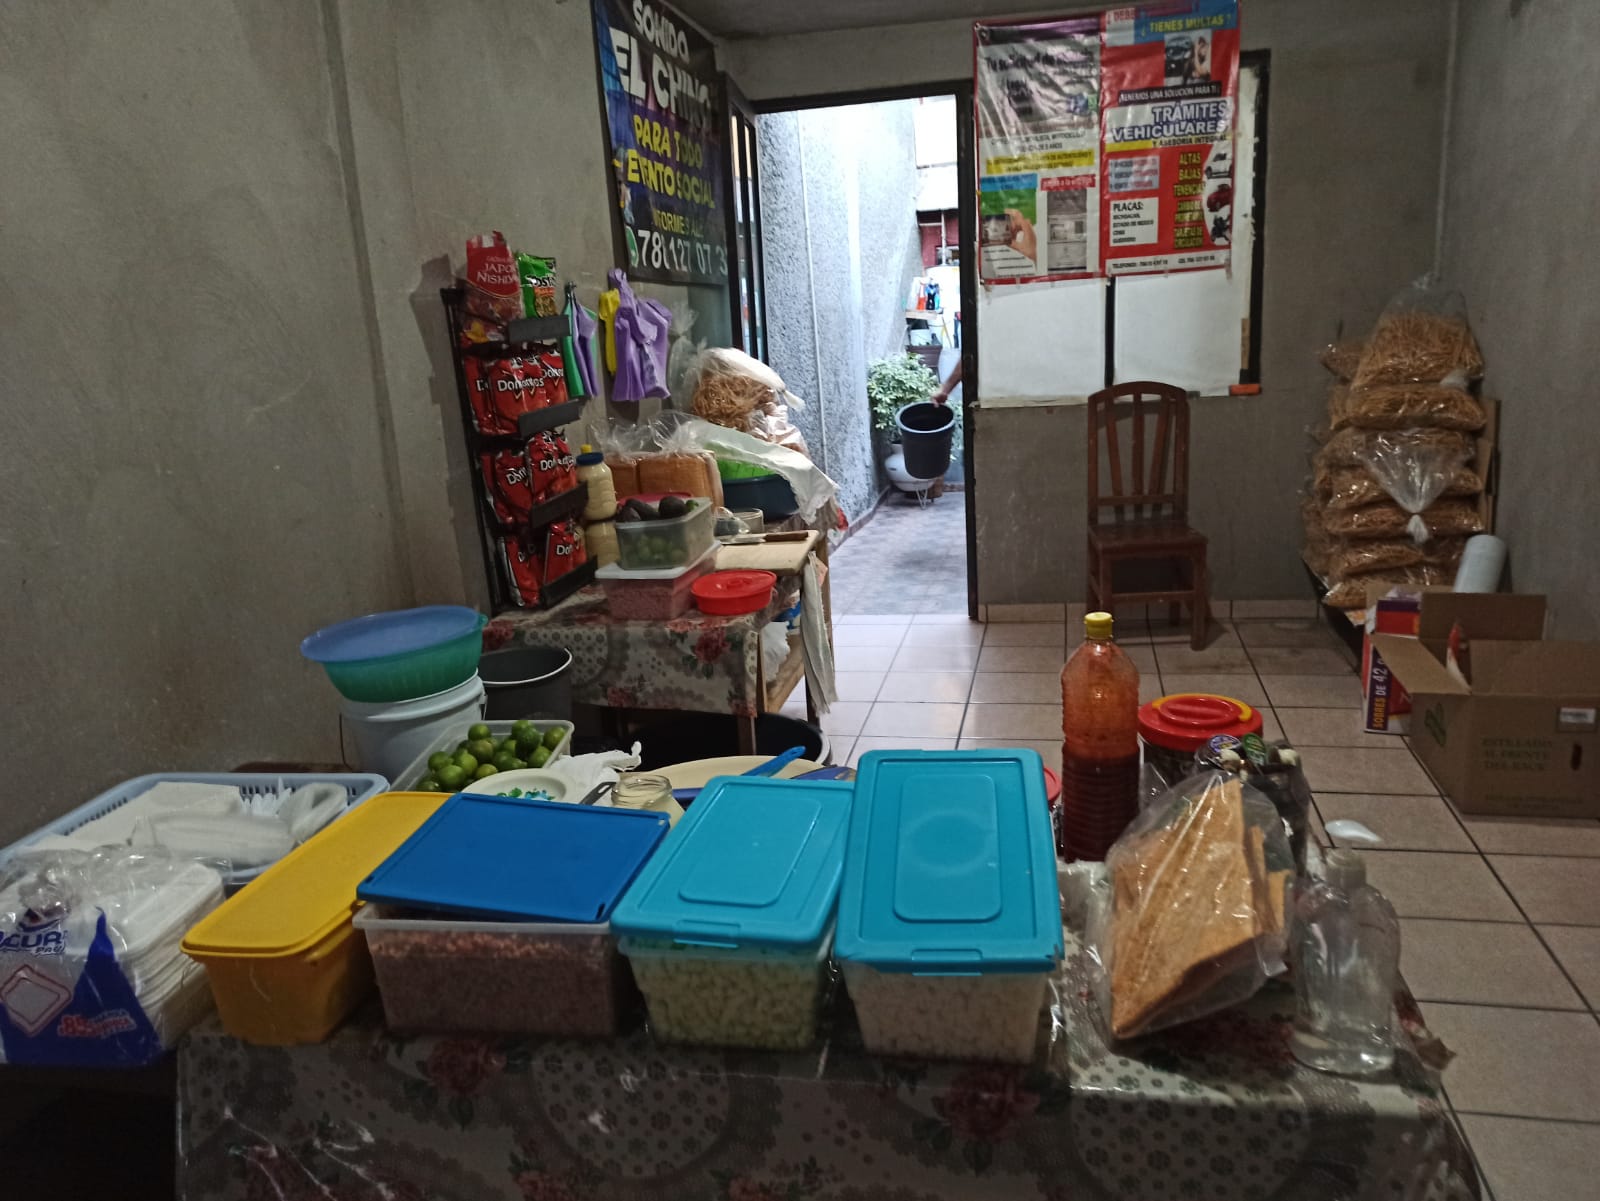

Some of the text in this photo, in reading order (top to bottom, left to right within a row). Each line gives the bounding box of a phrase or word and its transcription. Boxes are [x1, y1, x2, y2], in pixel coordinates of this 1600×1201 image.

[609, 26, 646, 99] EL
[633, 114, 672, 159] PARA
[1112, 119, 1227, 142] VEHICULARES
[1372, 667, 1388, 682] 42
[1375, 685, 1387, 696] DE
